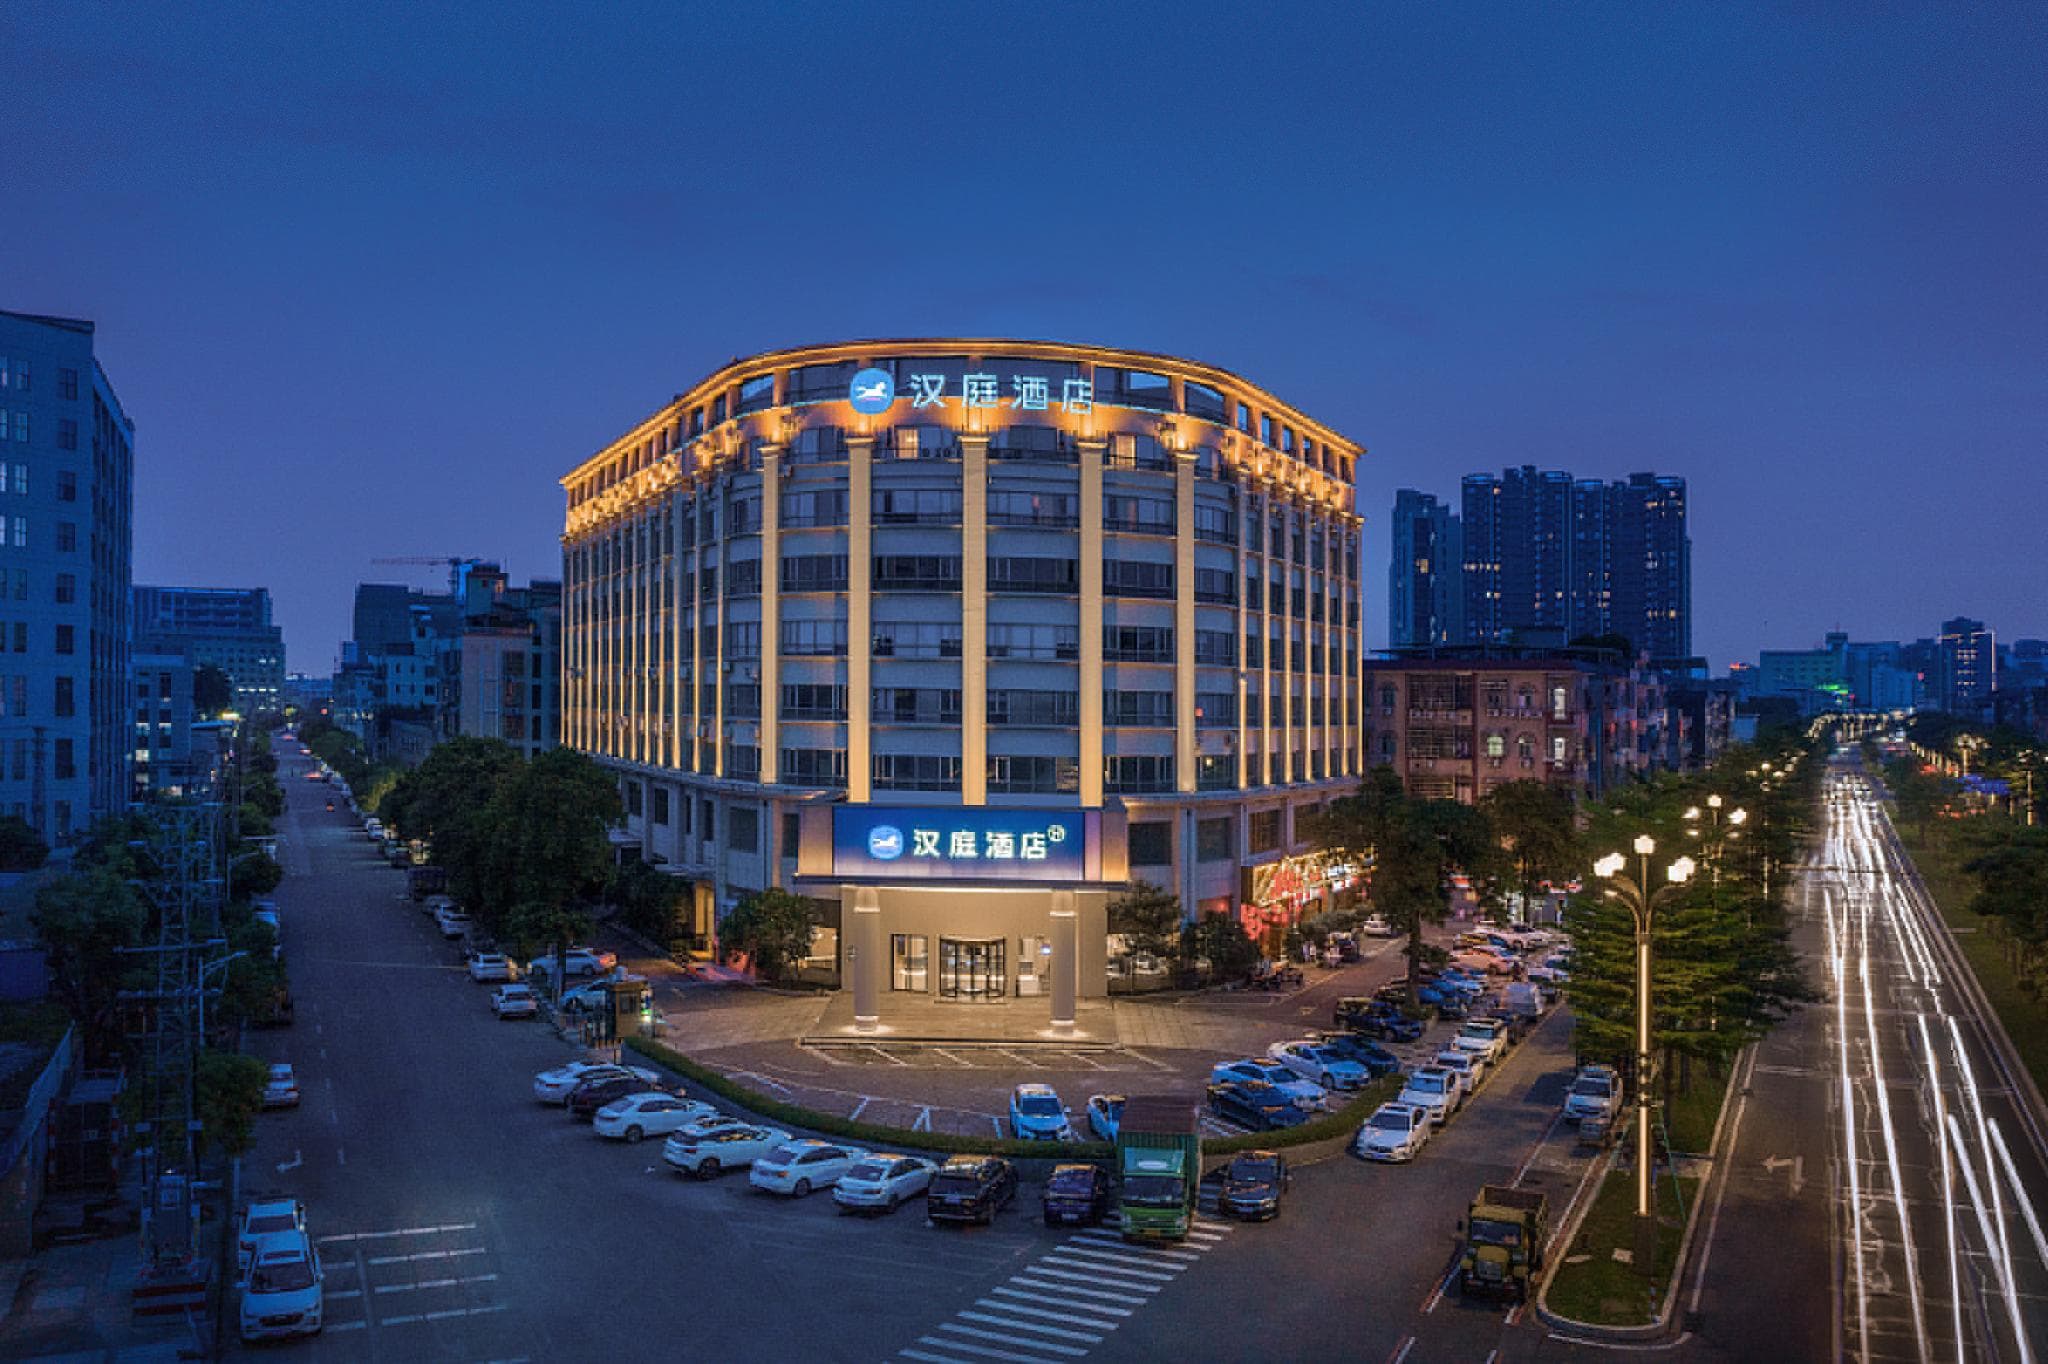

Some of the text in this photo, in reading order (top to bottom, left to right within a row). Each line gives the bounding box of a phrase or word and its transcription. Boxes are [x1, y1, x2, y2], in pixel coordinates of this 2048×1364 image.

[909, 373, 1092, 414] 汉庭酒店
[913, 829, 1047, 859] 汉庭酒店
